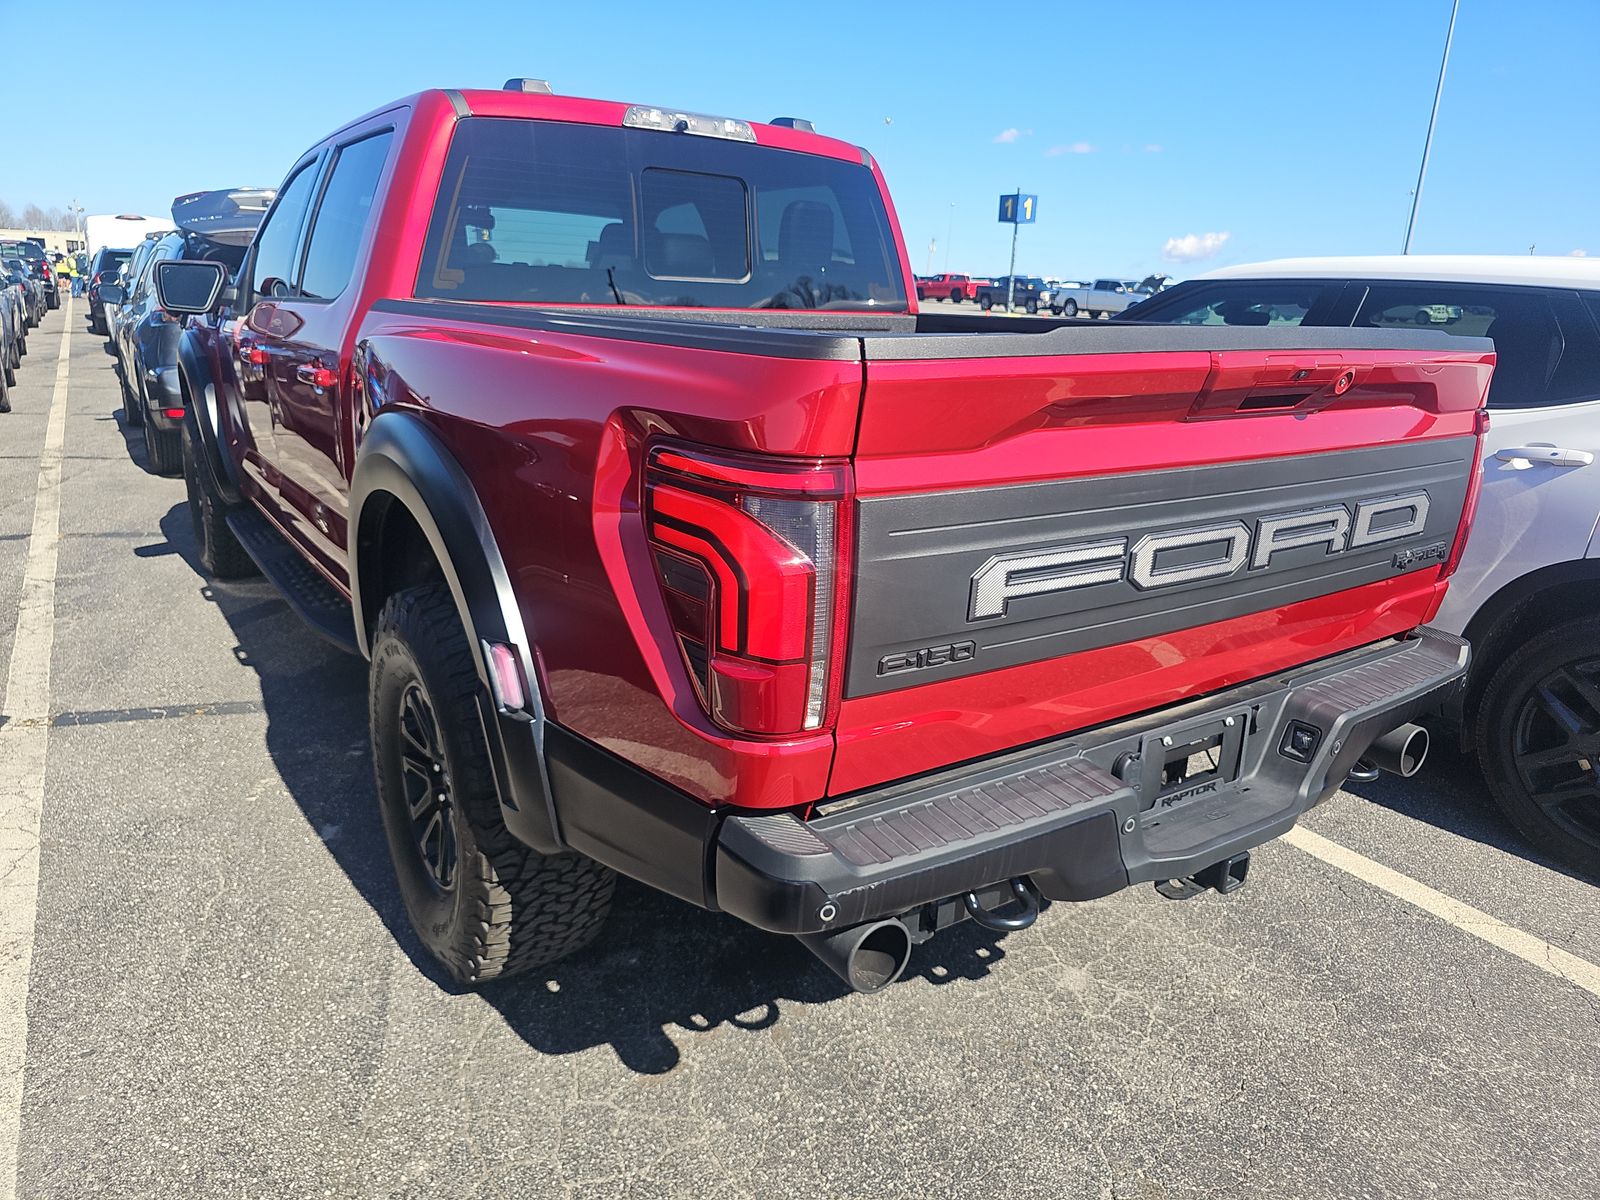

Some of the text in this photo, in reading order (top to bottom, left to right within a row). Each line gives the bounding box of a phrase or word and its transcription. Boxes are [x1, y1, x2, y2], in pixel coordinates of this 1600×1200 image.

[1004, 198, 1012, 219] 1
[1023, 197, 1033, 220] 1
[966, 488, 1432, 624] FORD
[1161, 782, 1217, 808] RAPTOR
